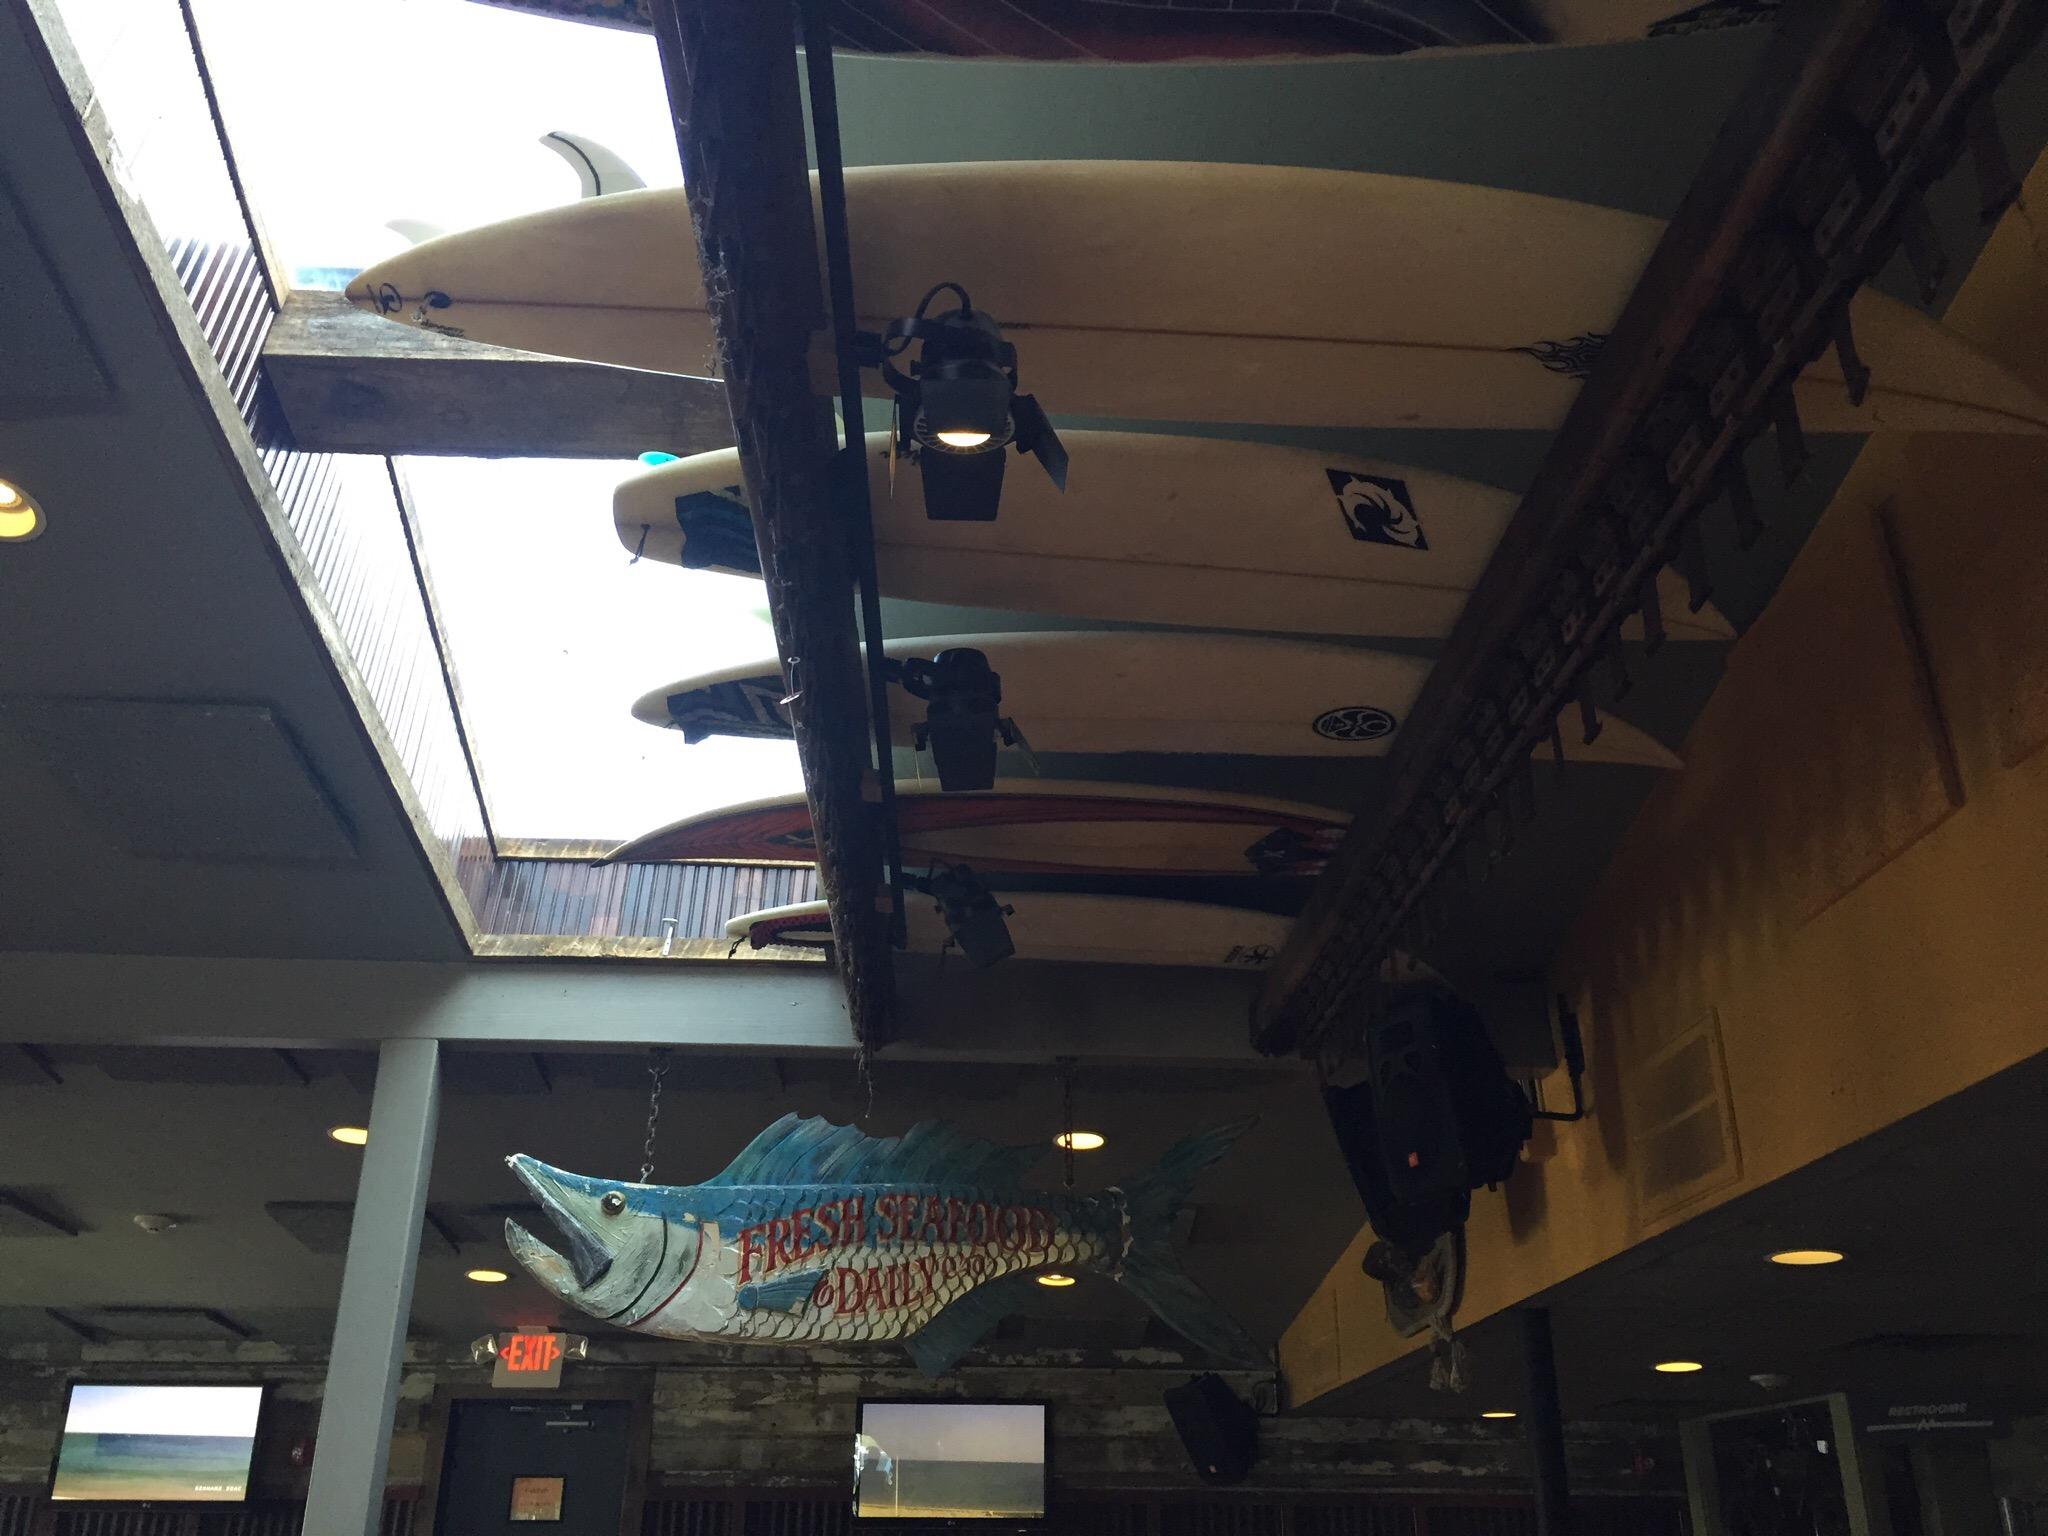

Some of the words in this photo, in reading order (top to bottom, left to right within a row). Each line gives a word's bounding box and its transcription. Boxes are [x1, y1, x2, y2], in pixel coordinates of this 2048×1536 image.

[738, 1196, 865, 1286] FRESH
[876, 1194, 1056, 1253] SEAFOOD
[834, 1251, 937, 1314] DAILY
[507, 1335, 556, 1372] EXIT
[1888, 1402, 1968, 1417] RESTROOMS
